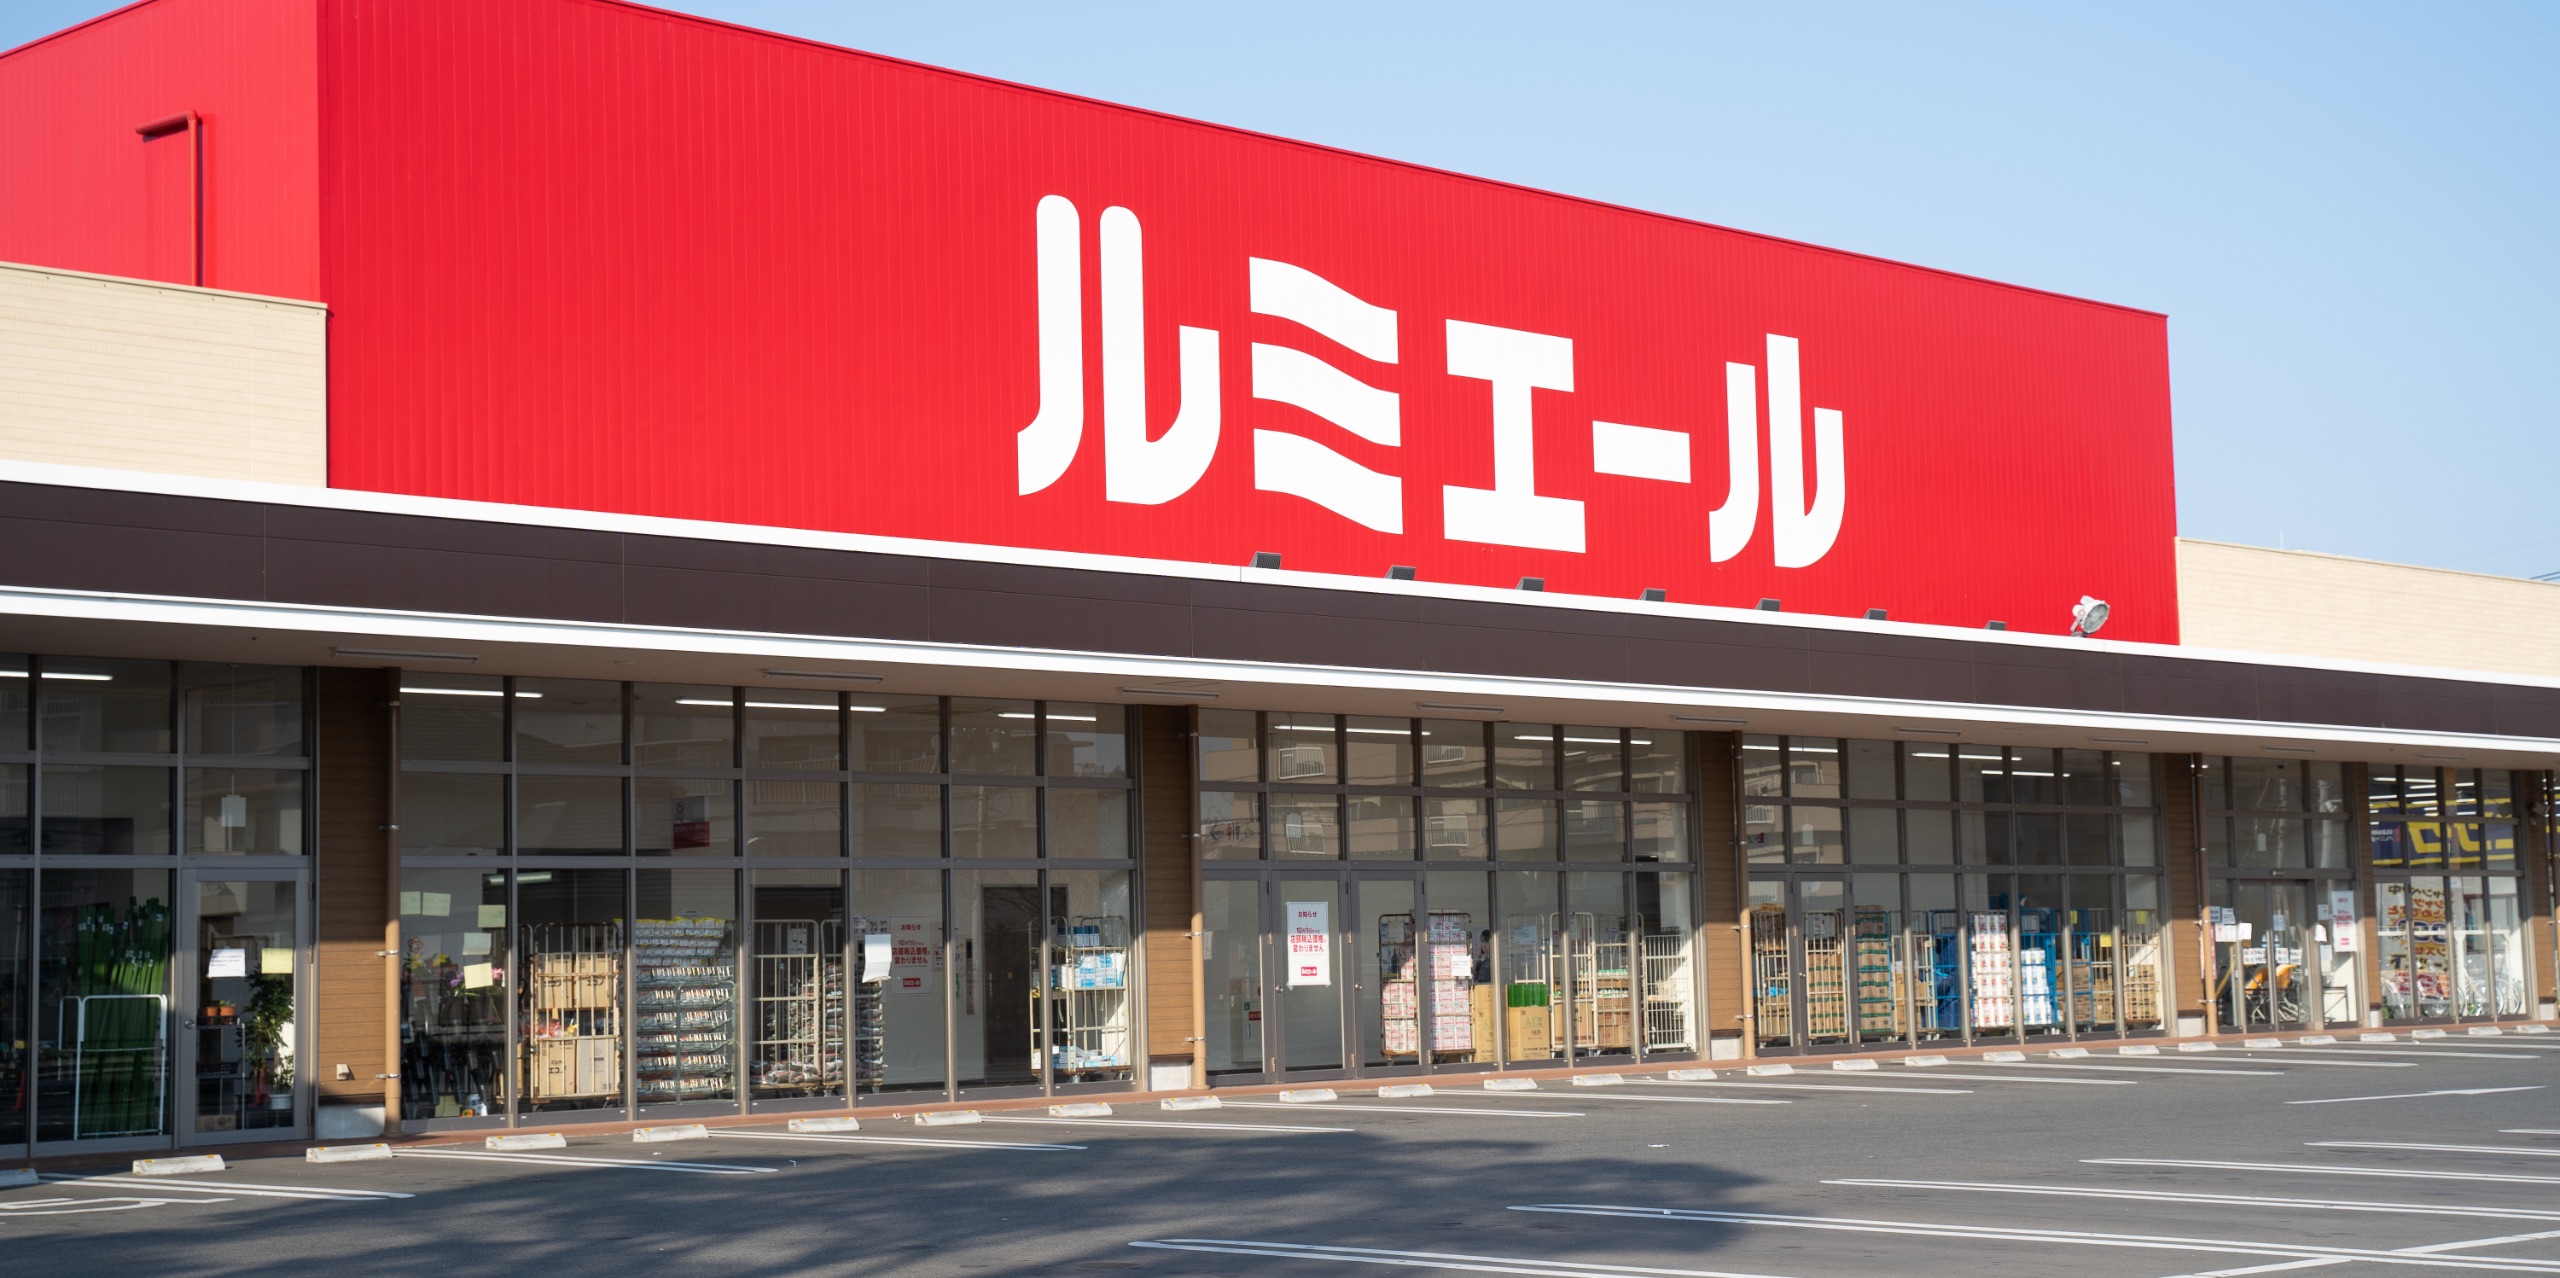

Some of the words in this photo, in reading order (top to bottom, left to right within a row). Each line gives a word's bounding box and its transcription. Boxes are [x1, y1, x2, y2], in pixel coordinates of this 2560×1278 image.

[1017, 194, 1846, 569] ルミエール
[1293, 944, 1324, 952] 変わりません
